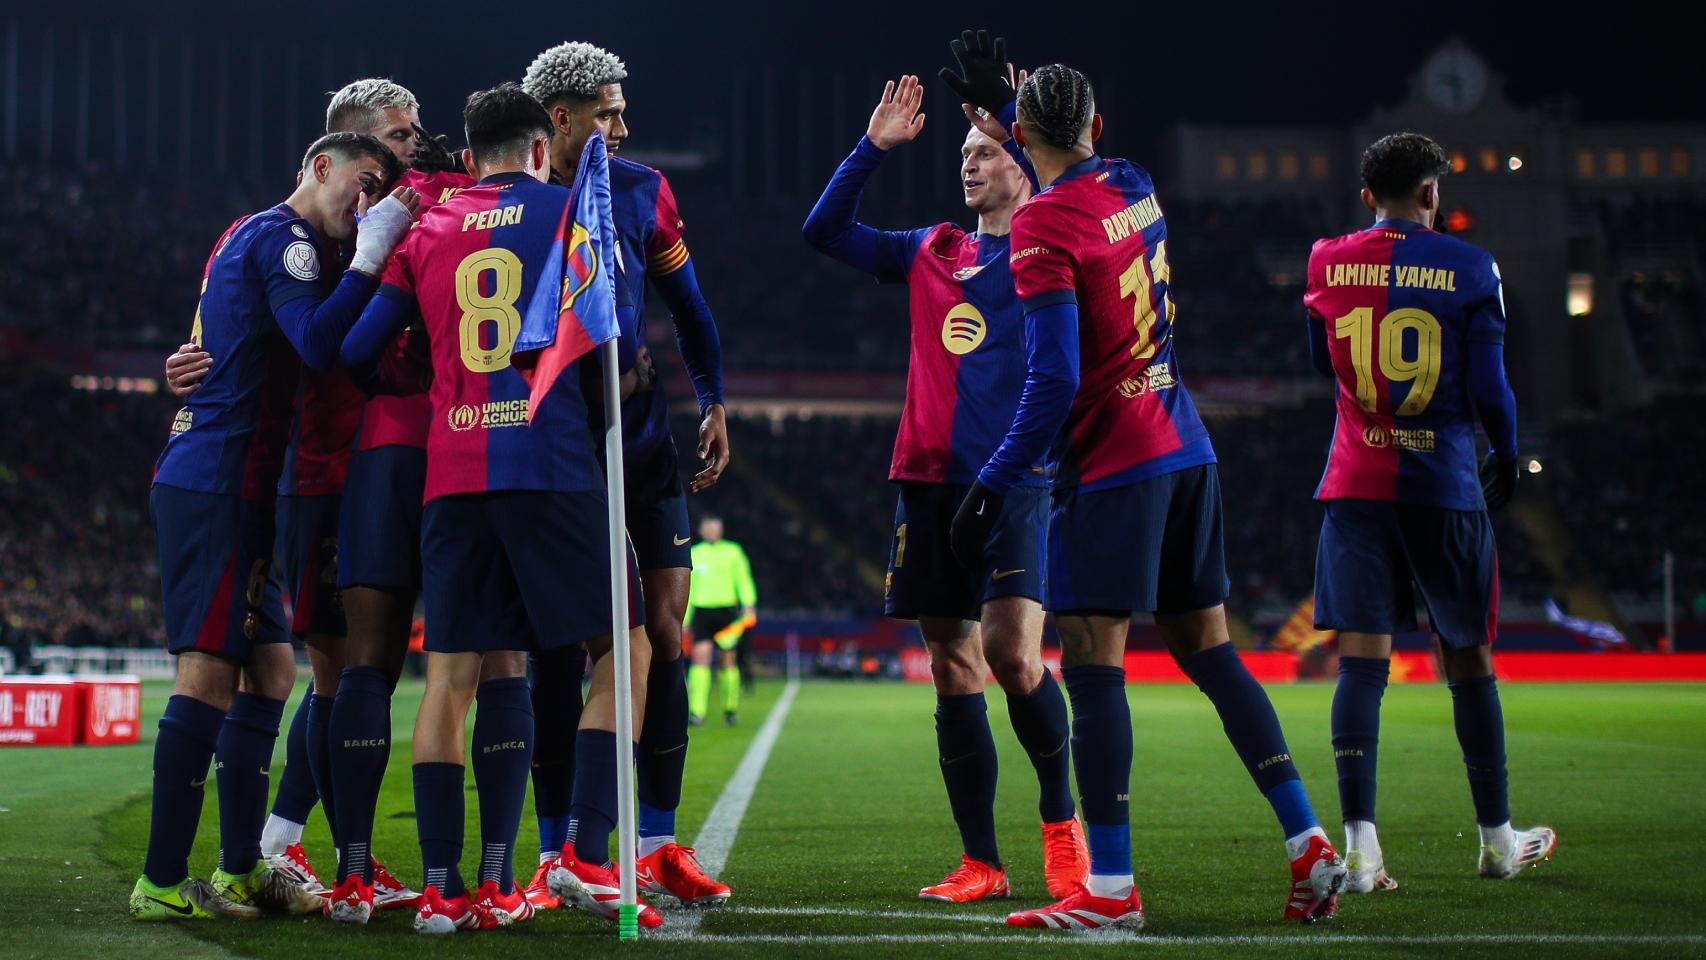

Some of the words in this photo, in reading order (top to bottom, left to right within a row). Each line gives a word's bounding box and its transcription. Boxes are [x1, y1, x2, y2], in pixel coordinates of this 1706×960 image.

[461, 204, 524, 232] PEDRI
[1101, 193, 1163, 244] RAPHINHA
[1325, 263, 1391, 287] LAMINE
[1395, 265, 1456, 292] YAMAL
[455, 247, 523, 373] 8
[1335, 307, 1441, 416] 19
[481, 410, 529, 425] ACNUR
[482, 400, 529, 414] UNHCR
[1391, 428, 1435, 440] UNHCR
[1392, 436, 1435, 449] ACNUR
